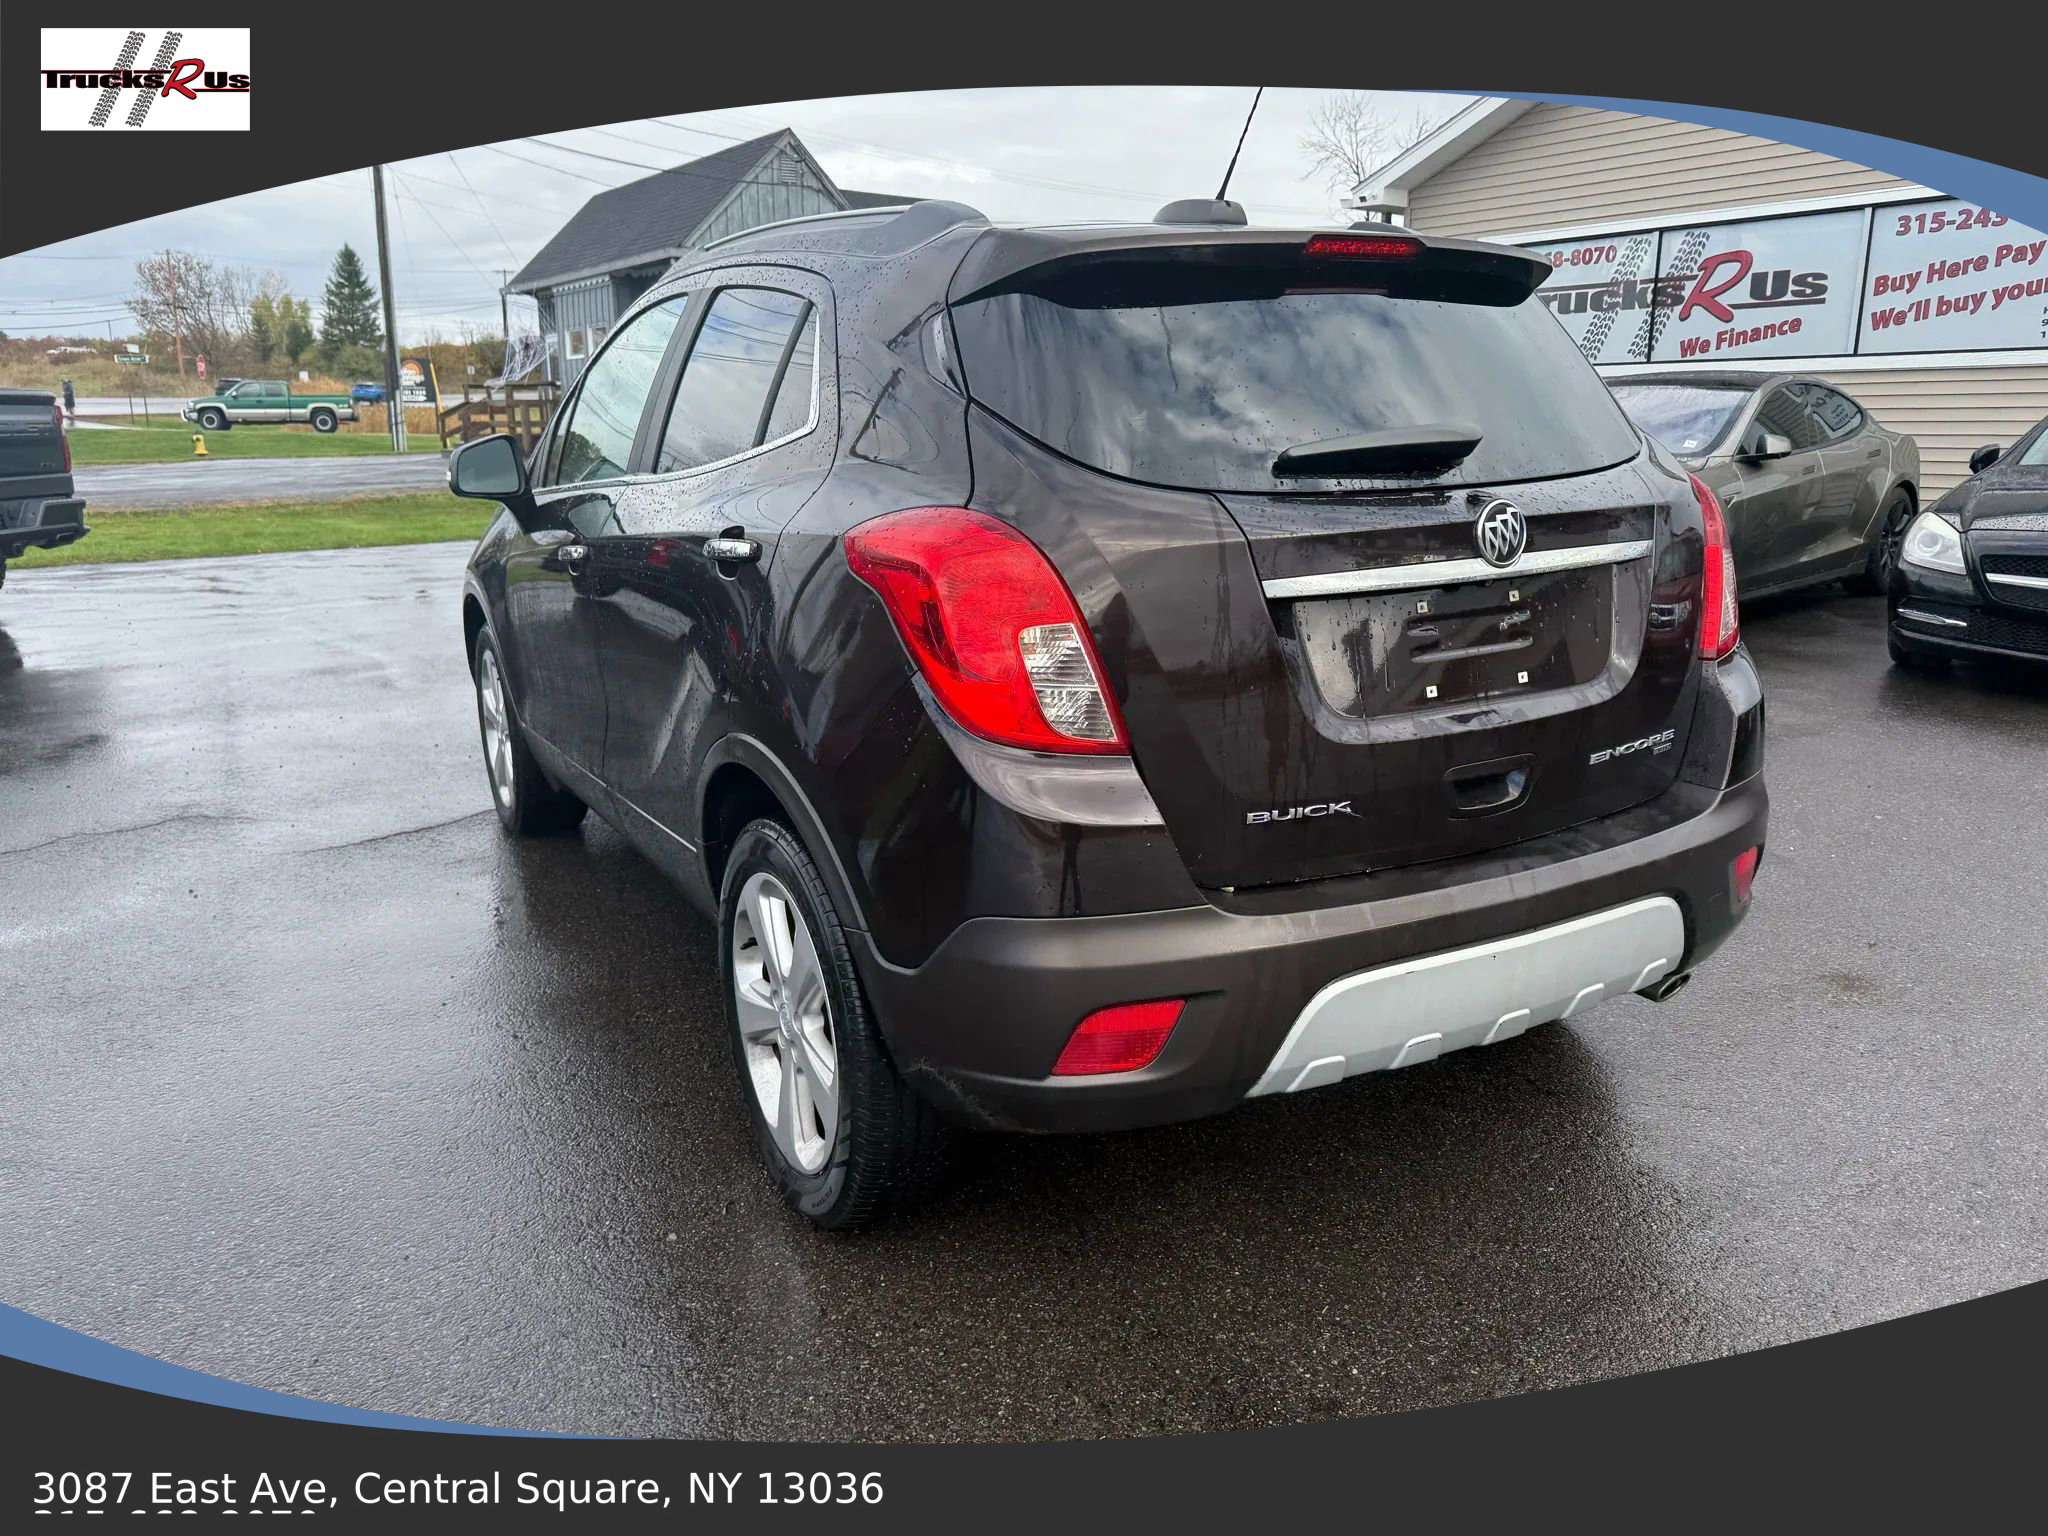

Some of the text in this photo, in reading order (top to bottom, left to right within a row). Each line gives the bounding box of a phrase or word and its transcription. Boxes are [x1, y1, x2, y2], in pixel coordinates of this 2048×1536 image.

[1539, 250, 1829, 323] rucks R Us
[1873, 240, 2047, 296] Buy Here Pay
[1871, 298, 1931, 331] We'll
[1935, 291, 1987, 317] buy
[1679, 317, 1803, 358] We Finance
[1588, 729, 1675, 765] ENCORE
[1246, 800, 1353, 824] BUICK
